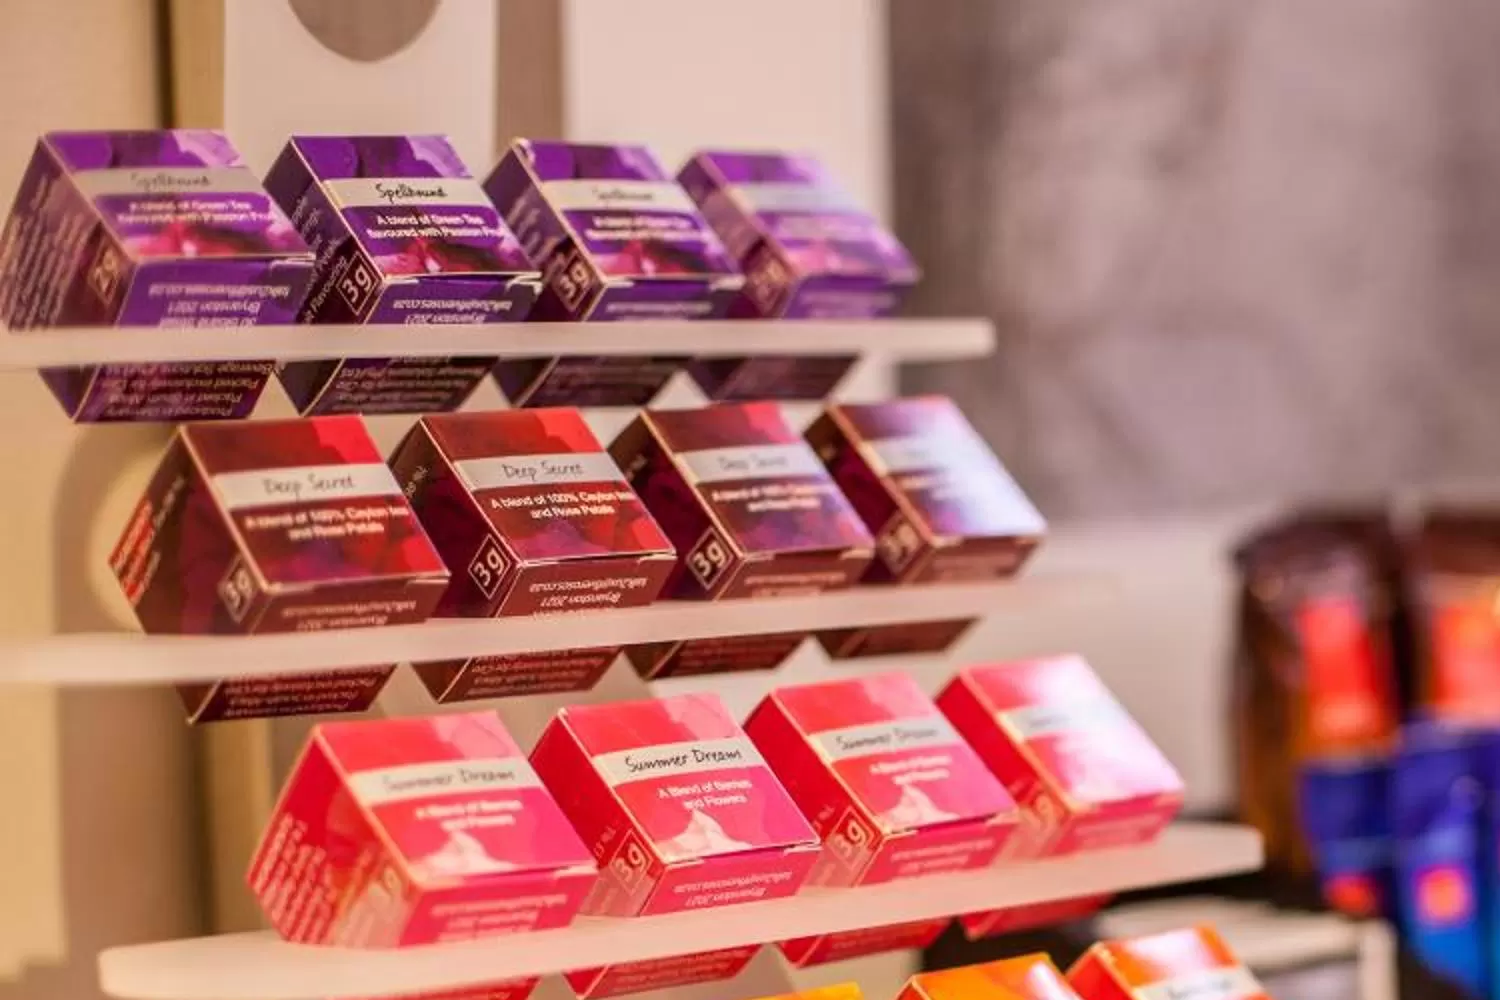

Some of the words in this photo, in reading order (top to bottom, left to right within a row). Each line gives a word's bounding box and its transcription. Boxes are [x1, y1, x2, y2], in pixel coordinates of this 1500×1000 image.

[341, 262, 373, 303] 3g
[557, 261, 591, 299] 3g
[473, 549, 506, 588] 3g
[691, 748, 743, 763] Dream
[613, 843, 648, 881] 3g
